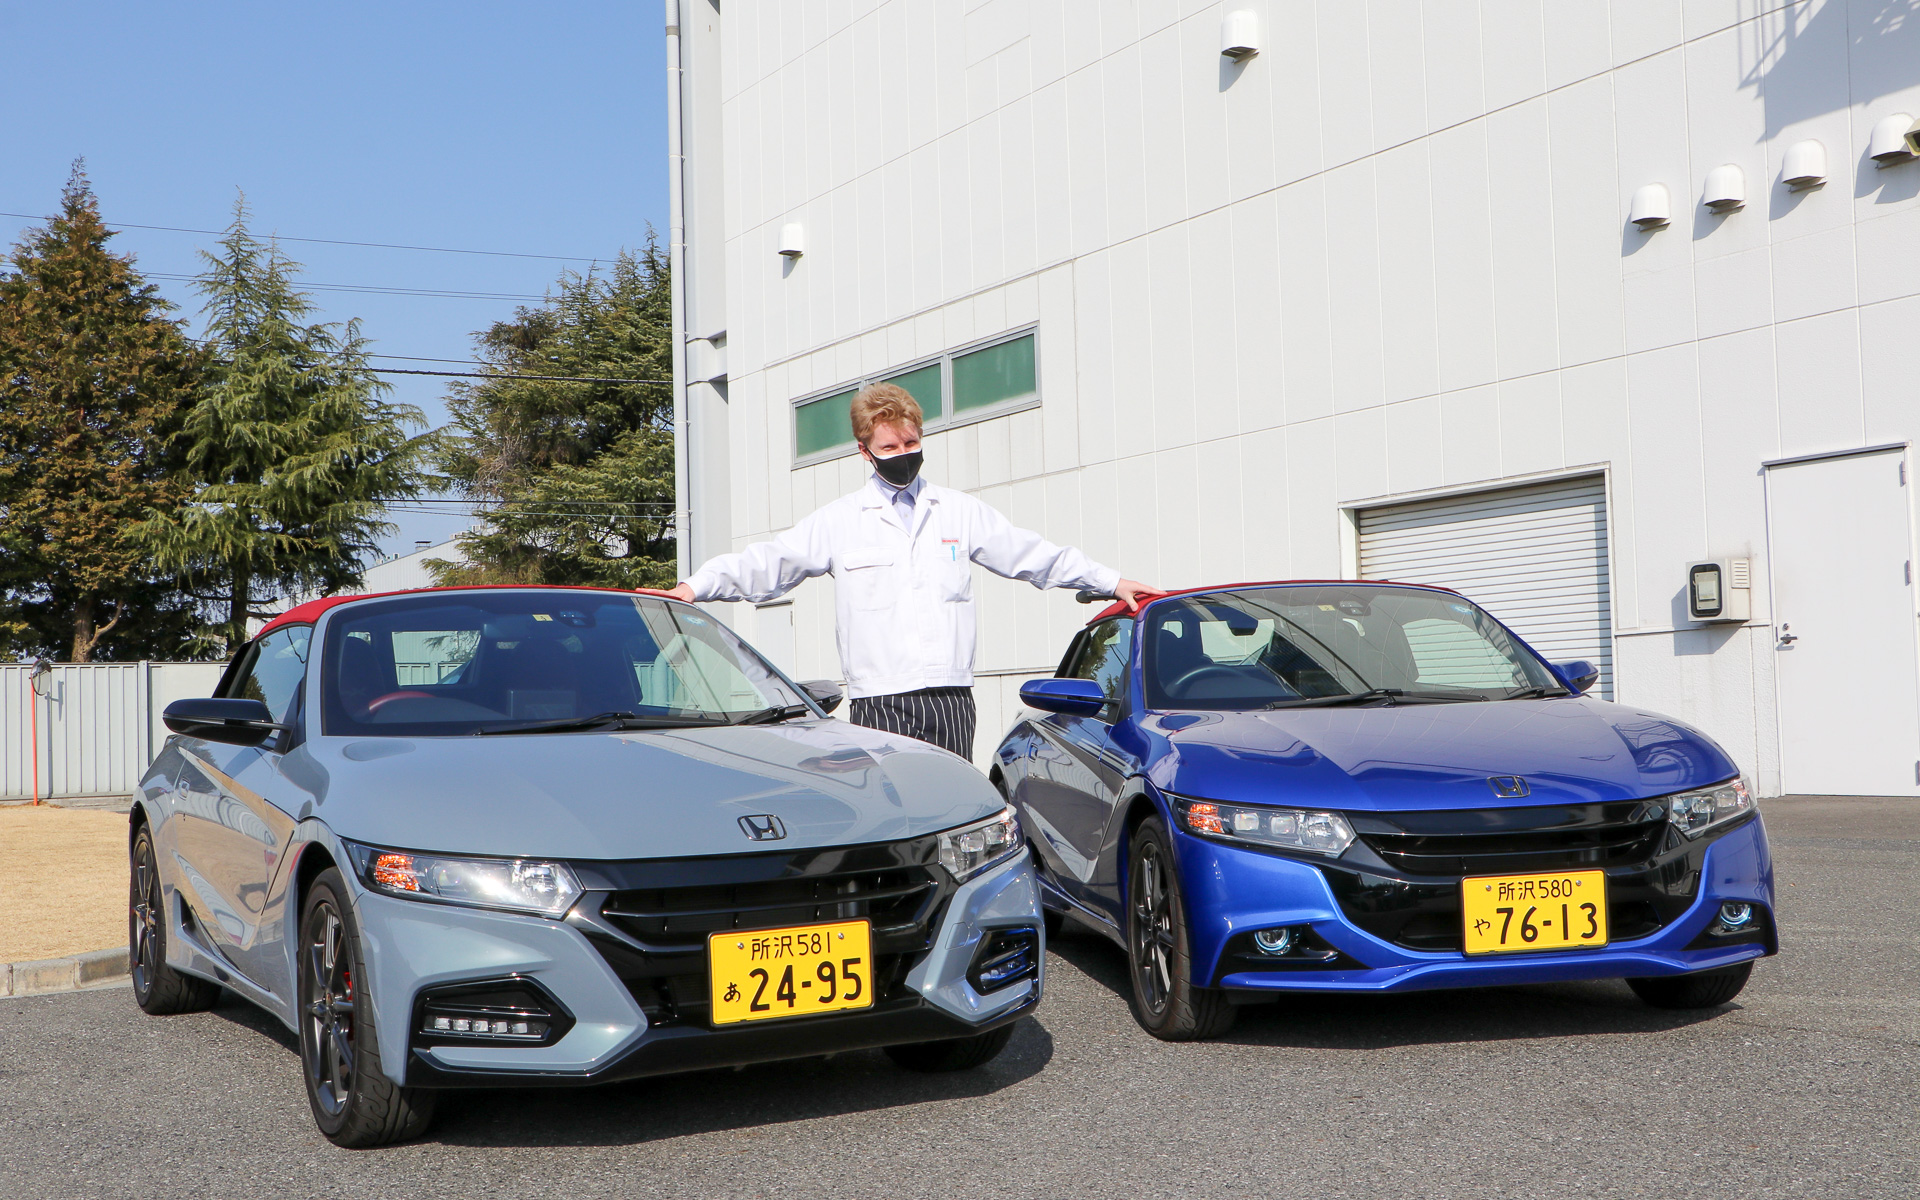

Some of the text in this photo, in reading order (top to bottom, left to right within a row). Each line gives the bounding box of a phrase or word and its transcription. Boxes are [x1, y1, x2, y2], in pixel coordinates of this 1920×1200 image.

[1498, 879, 1572, 901] 所沢580
[1474, 903, 1597, 944] や 76-13
[751, 932, 831, 960] 所沢581
[723, 957, 862, 1012] あ 24-95
